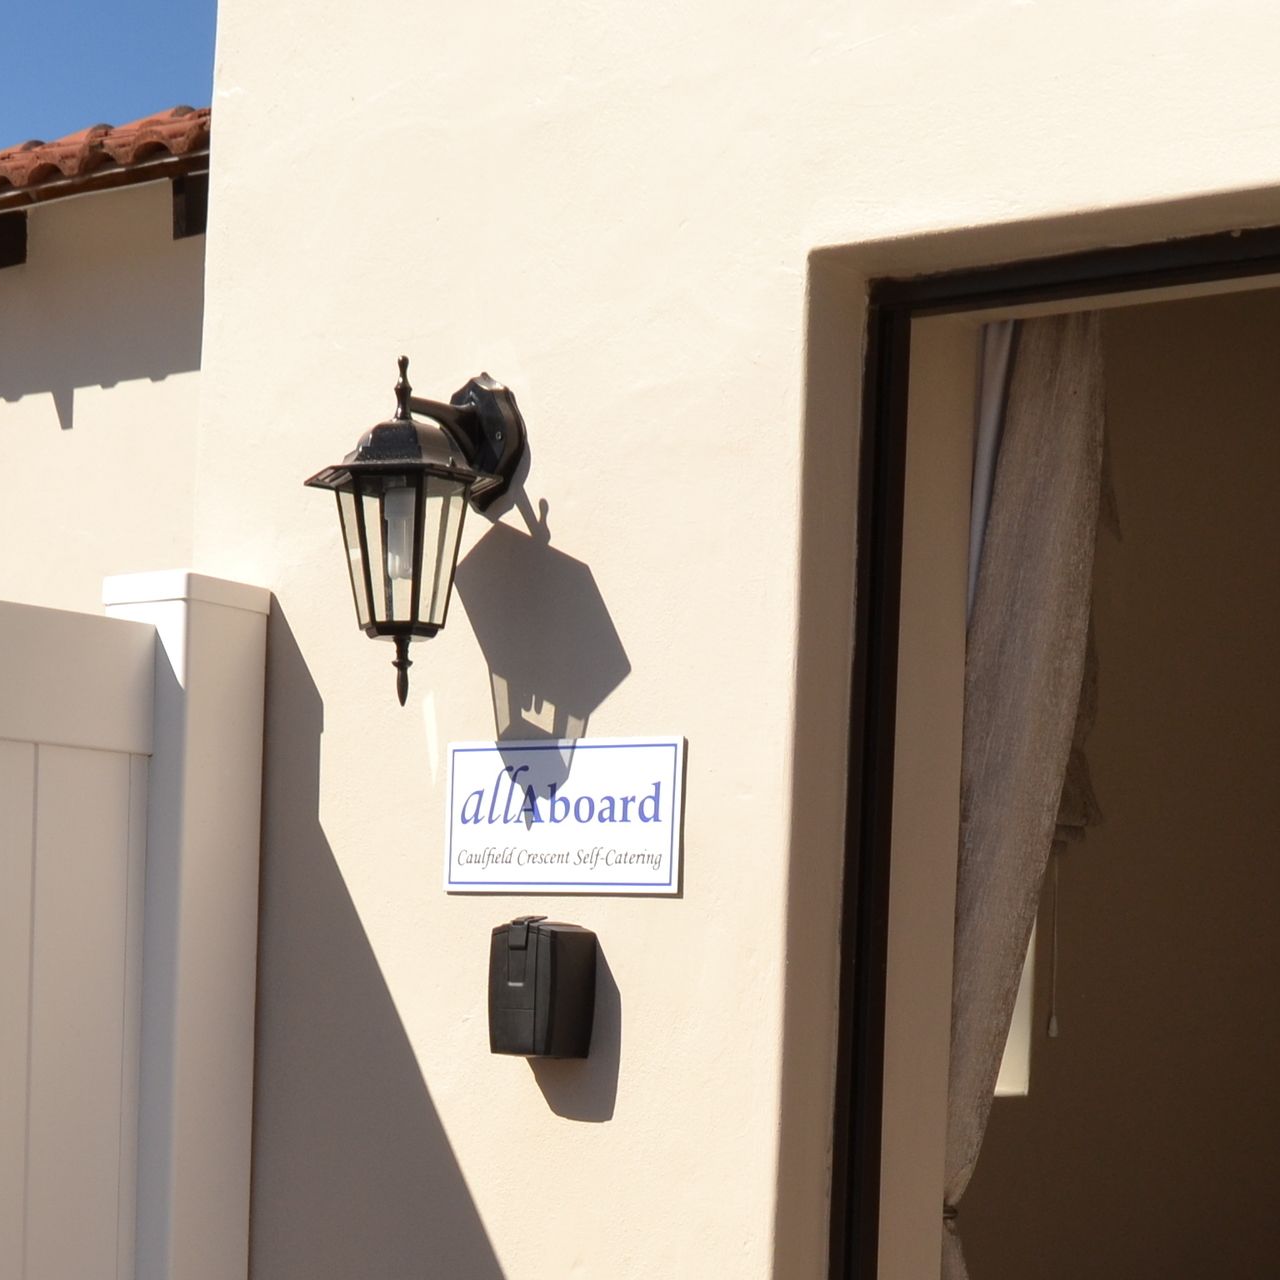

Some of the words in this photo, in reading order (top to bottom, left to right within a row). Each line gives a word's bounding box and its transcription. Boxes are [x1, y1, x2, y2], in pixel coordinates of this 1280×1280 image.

[457, 846, 517, 870] Caulfield
[517, 848, 570, 867] Crescent
[573, 846, 663, 871] Self-Catering
